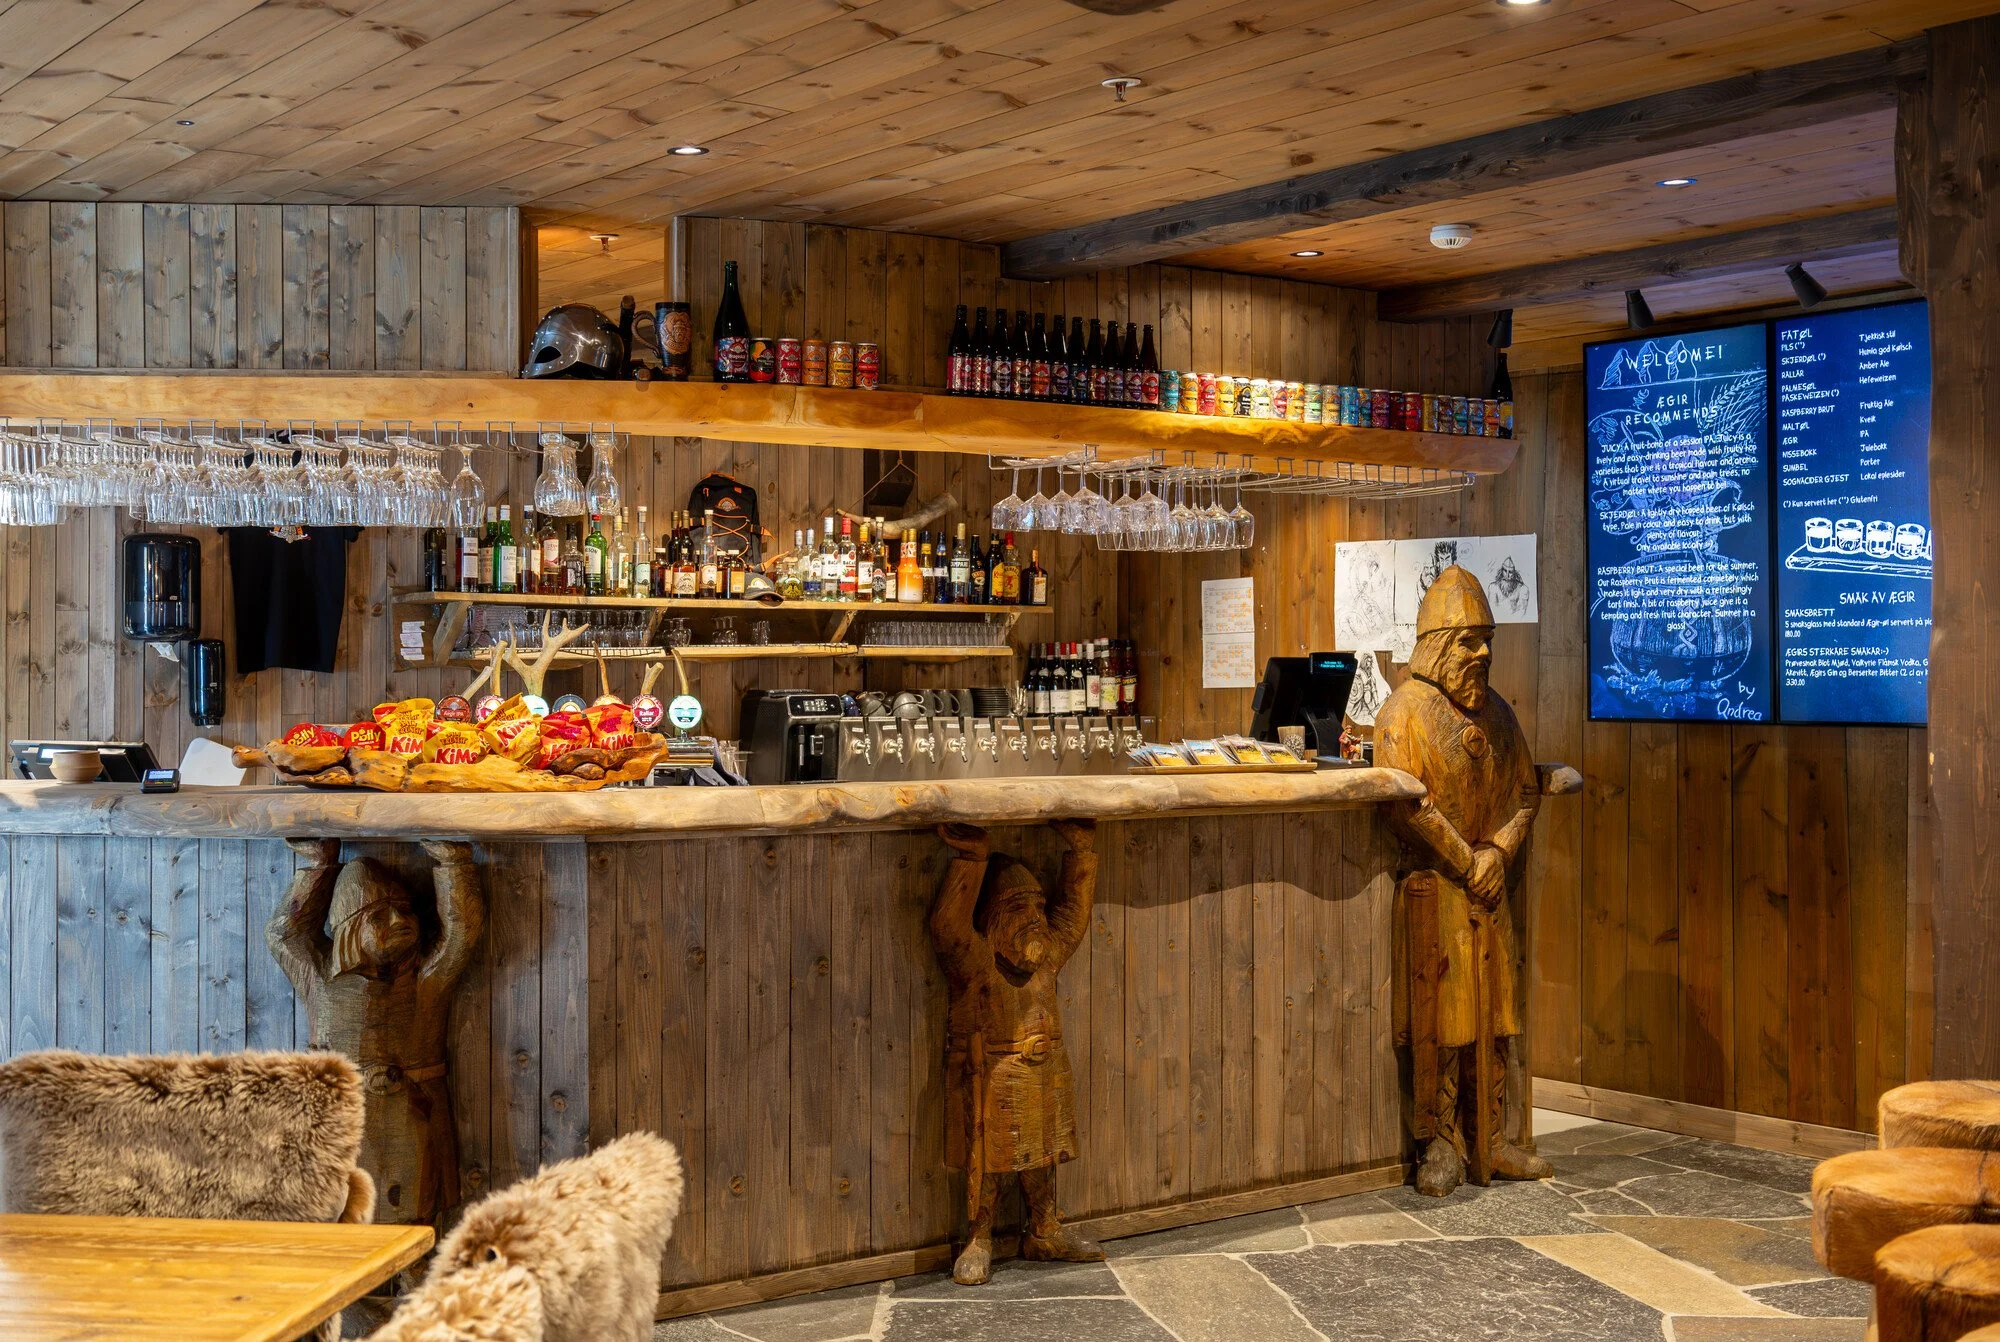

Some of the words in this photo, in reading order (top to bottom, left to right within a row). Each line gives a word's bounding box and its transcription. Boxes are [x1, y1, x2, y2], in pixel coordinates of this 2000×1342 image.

[1859, 331, 1885, 342] Tjekkisk
[1879, 346, 1890, 354] god
[1782, 355, 1816, 365] SKJERDØL
[1859, 375, 1896, 384] Hefeweizen
[1657, 394, 1688, 408] ÆGIR
[1860, 401, 1883, 410] Fruktig
[1818, 405, 1835, 413] BRUT
[1860, 415, 1876, 423] Kveik
[1680, 437, 1702, 446] session
[1783, 437, 1798, 445] ÆGIR
[1860, 443, 1887, 452] Julebokk
[1627, 451, 1669, 462] easy-drinking
[1724, 445, 1743, 454] fruity
[1746, 444, 1756, 452] hop
[1783, 448, 1817, 458] NISSEBOKK
[1595, 466, 1623, 476] varieties
[1624, 465, 1638, 473] that
[1640, 464, 1653, 472] give
[1669, 461, 1693, 471] tropical
[1695, 459, 1717, 467] flavour
[1734, 456, 1758, 465] aroma.
[1783, 464, 1808, 472] SUMBEL
[1610, 476, 1629, 485] virtual
[1632, 475, 1651, 484] travel
[1661, 472, 1686, 481] sunshine
[1702, 470, 1717, 479] palm
[1825, 474, 1849, 483] GJEST
[1878, 470, 1905, 480] eplesider
[1648, 485, 1667, 494] where
[1669, 485, 1681, 494] you
[1682, 482, 1705, 492] happen
[1804, 498, 1826, 506] servert
[1850, 495, 1878, 503] Glutenfri
[1648, 508, 1666, 517] lightly
[1682, 505, 1704, 516] hopped
[1706, 504, 1722, 512] beer
[1677, 520, 1694, 528] easy
[1647, 533, 1667, 541] plenty
[1636, 544, 1650, 552] Only
[1652, 542, 1680, 551] available
[1682, 540, 1702, 549] locally
[1598, 566, 1634, 576] RASPBERRY
[1665, 564, 1687, 573] special
[1611, 578, 1643, 587] Raspberry
[1667, 575, 1701, 584] fermented
[1703, 574, 1739, 584] completely
[1741, 572, 1758, 582] which
[1631, 588, 1644, 597] light
[1712, 585, 1752, 595] refreshingly
[1889, 591, 1915, 604] ÆGIR
[1667, 599, 1699, 609] raspberry
[1701, 597, 1717, 607] juice
[1720, 597, 1733, 606] give
[1601, 611, 1628, 621] tempting
[1678, 608, 1713, 617] character.
[1791, 620, 1822, 629] smaksglass
[1823, 619, 1835, 627] med
[1837, 618, 1864, 627] standard
[1890, 618, 1914, 626] servert
[1915, 617, 1923, 626] på
[1786, 648, 1807, 657] ÆGIRS
[1786, 659, 1817, 667] Prøvesmak
[1810, 669, 1825, 678] Ægirs
[1848, 669, 1878, 677] Berserker
[1880, 668, 1898, 676] Bitter
[1739, 681, 1755, 700] by
[351, 727, 381, 742] Polly
